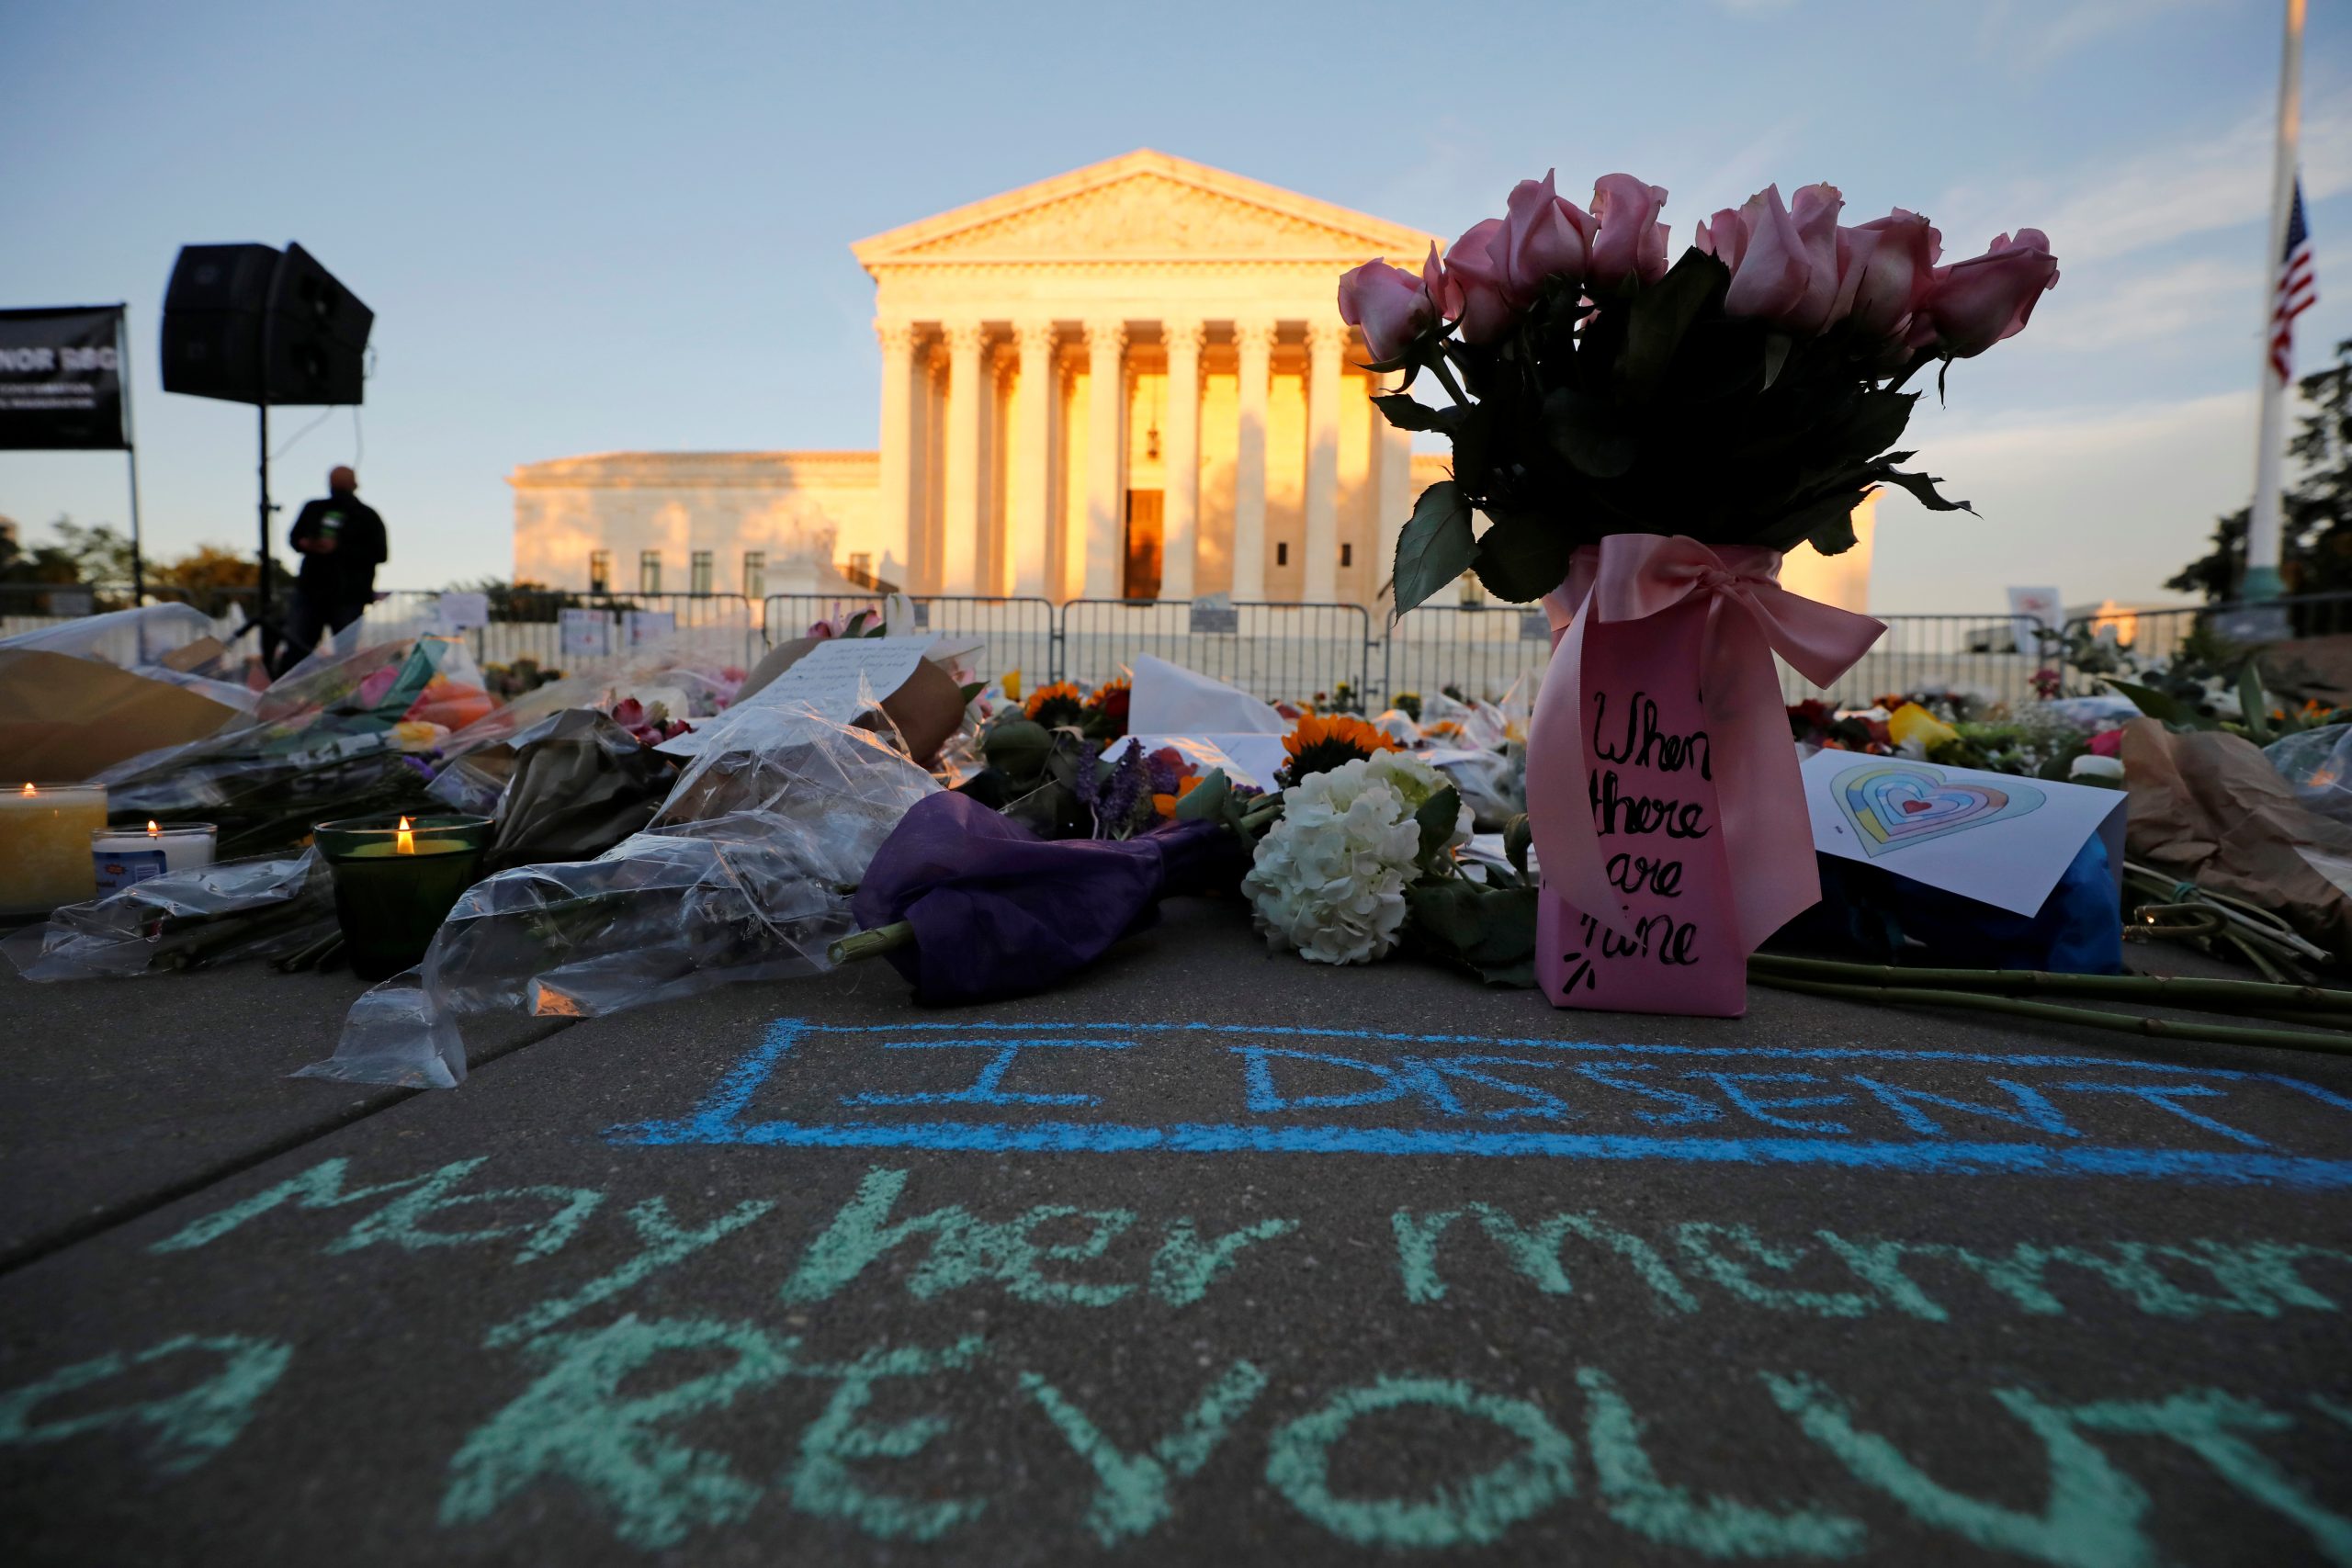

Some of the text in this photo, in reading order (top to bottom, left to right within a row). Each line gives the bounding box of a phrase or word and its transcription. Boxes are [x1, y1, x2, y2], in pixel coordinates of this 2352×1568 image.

[1593, 691, 1713, 781] When
[1589, 768, 1713, 839] there
[1607, 852, 1683, 898] are
[841, 1040, 2267, 1150] I DISSENT
[779, 1165, 1299, 1309] her
